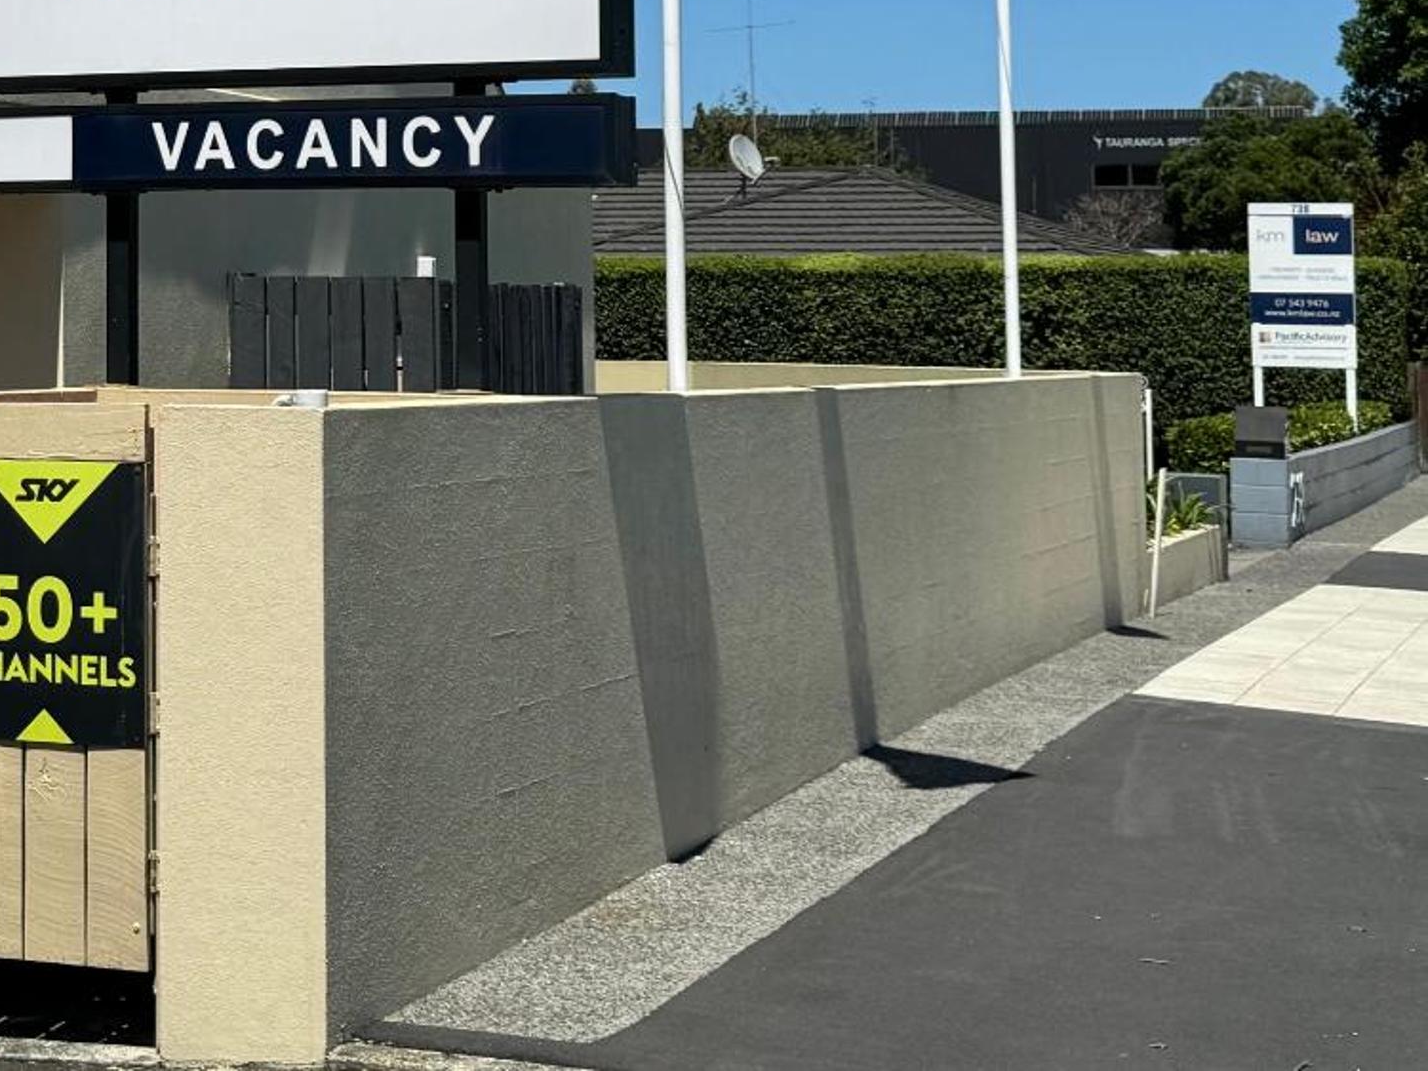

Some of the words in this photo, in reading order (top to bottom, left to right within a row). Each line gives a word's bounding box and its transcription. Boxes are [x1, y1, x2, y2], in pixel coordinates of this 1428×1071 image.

[151, 114, 495, 172] VACANCY
[1105, 137, 1165, 148] TAURANGA
[1305, 229, 1340, 244] law
[15, 478, 80, 503] SKY
